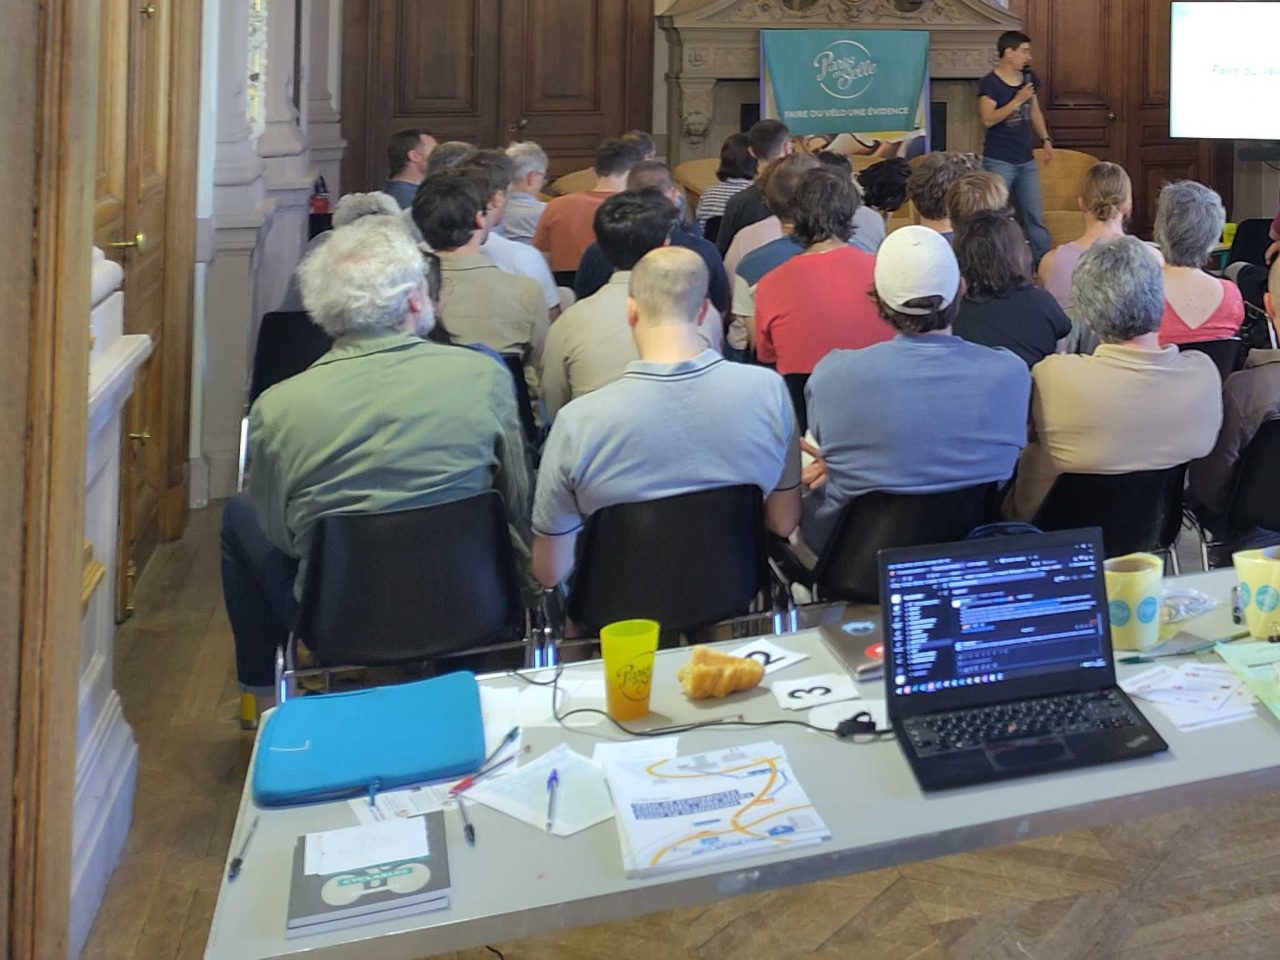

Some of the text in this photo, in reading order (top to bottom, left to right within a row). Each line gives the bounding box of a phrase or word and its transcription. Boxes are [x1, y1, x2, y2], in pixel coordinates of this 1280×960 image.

[784, 105, 909, 119] FAIRE DU VÉLO UNE ÉVIDENCE
[787, 686, 832, 699] 3
